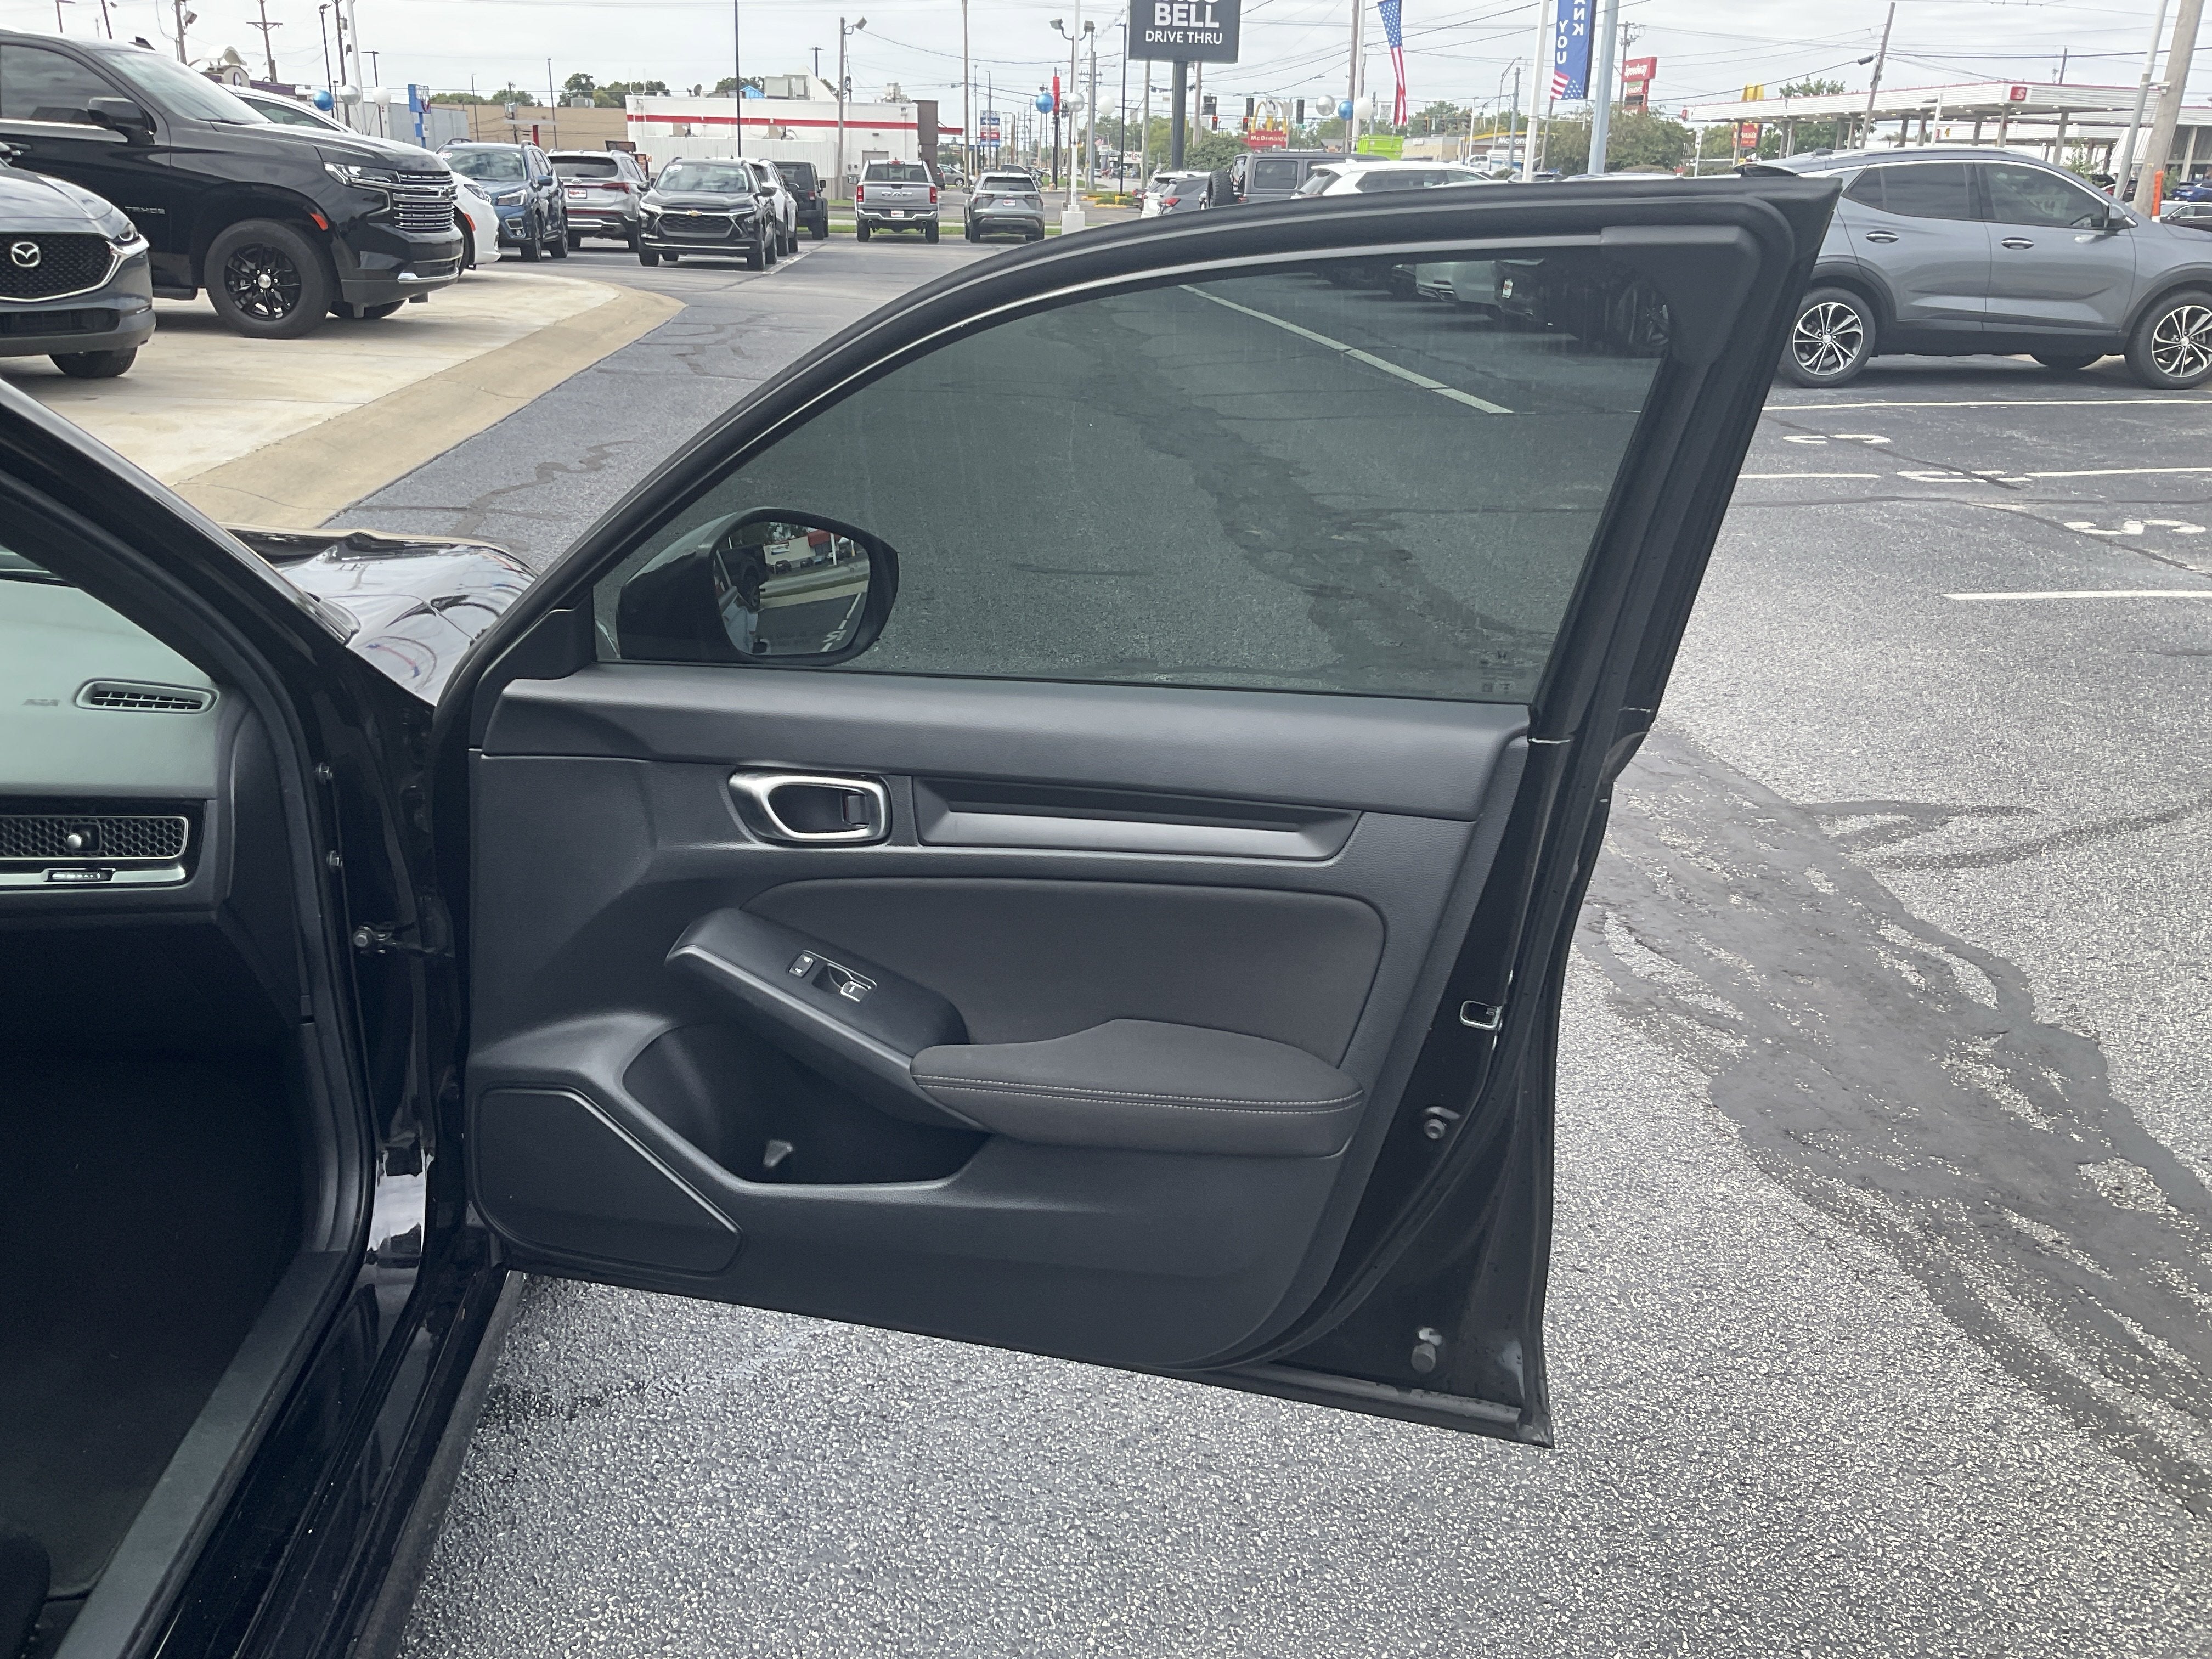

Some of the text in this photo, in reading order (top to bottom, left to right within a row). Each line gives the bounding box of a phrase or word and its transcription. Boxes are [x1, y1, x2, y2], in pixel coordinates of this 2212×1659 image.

[1154, 3, 1219, 28] BELL
[1146, 30, 1222, 44] DRIVE THRU
